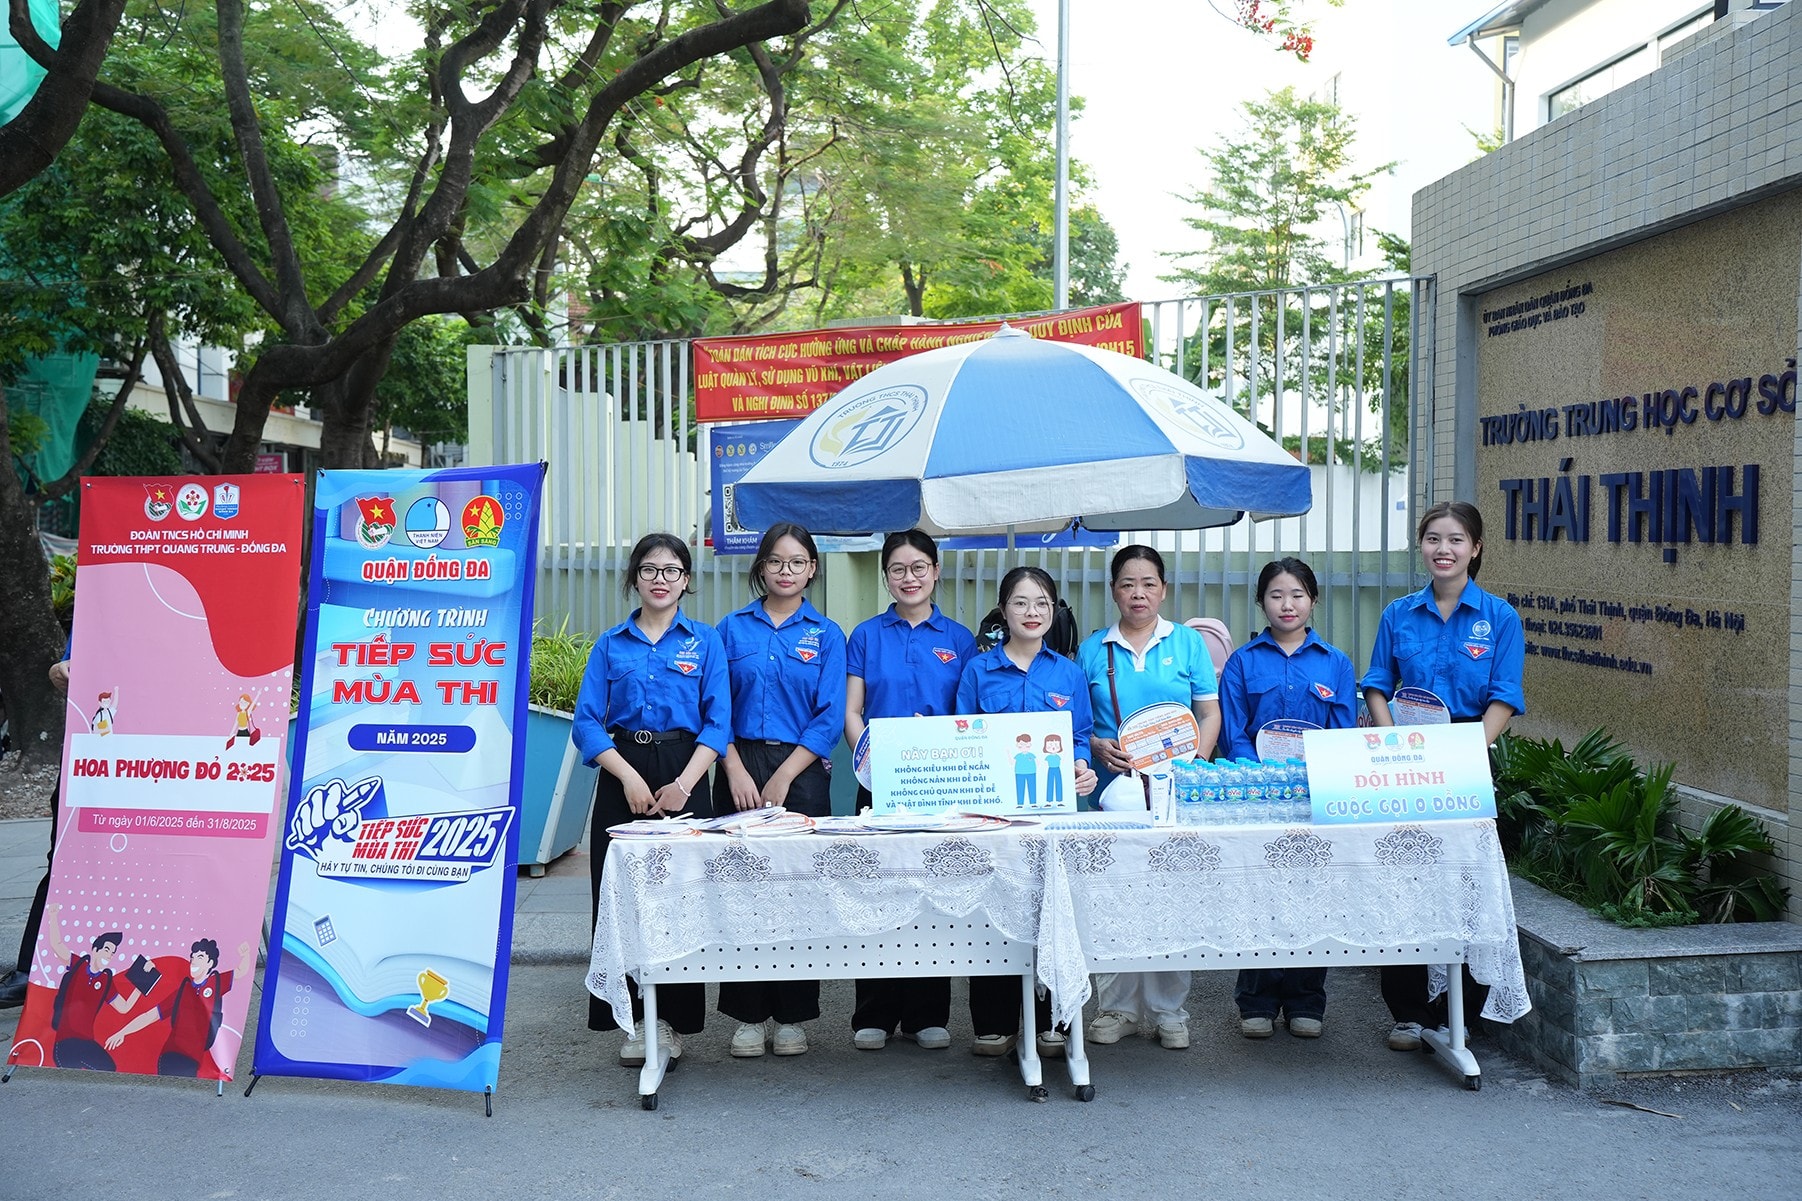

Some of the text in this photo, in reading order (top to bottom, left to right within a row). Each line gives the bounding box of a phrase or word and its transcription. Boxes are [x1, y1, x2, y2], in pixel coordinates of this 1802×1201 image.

[1569, 301, 1586, 319] TẠO
[733, 344, 752, 362] DÂN
[754, 343, 777, 361] TÍCH
[777, 343, 798, 362] CỰC
[799, 337, 832, 358] HƯỞNG
[834, 338, 857, 355] ỨNG
[859, 333, 874, 353] VÀ
[875, 331, 908, 352] CHẤP
[910, 333, 945, 350] HÀNH
[1028, 322, 1055, 339] QUY
[1057, 317, 1093, 338] ĐỊNH
[1095, 309, 1123, 331] CỦA
[698, 370, 718, 391] LUẬT
[746, 367, 762, 387] LÝ,
[761, 365, 776, 386] SỬ
[776, 369, 804, 389] DỤNG
[805, 366, 819, 383] VŨ
[820, 365, 842, 383] KHÍ,
[732, 394, 744, 412] VÀ
[746, 396, 768, 414] NGHỊ
[770, 395, 794, 414] ĐỊNH
[796, 388, 809, 410] SỐ
[1480, 403, 1559, 446] TRƯỜNG
[1562, 395, 1638, 437] TRUNG
[1643, 386, 1699, 435] HỌC
[1704, 377, 1752, 421] CƠ
[1499, 457, 1760, 564] THÁI THỊNH
[130, 527, 249, 541] ĐOÀN TNCS HỒ CHÍ MINH
[91, 542, 132, 554] TRƯỜNG
[134, 544, 161, 554] THPT
[162, 544, 199, 554] QUANG
[200, 543, 235, 554] TRUNG
[241, 540, 270, 553] ĐỐNG
[271, 543, 287, 553] ĐA
[362, 554, 490, 582] QUẬN ĐỐNG ĐA
[363, 606, 488, 627] CHƯƠNG TRÌNH
[1578, 598, 1597, 616] Thái
[1598, 600, 1627, 621] Thịnh,
[1628, 604, 1653, 624] quận
[1706, 608, 1721, 629] Hà
[1724, 611, 1745, 636] Nội
[331, 632, 507, 667] TIẾP SỨC
[331, 673, 499, 705] MÙA THI
[376, 729, 447, 745] NĂM 2025
[901, 746, 928, 761] NÀY
[930, 748, 958, 762] BẠN
[978, 746, 983, 758] !
[73, 758, 109, 778] HOA
[115, 757, 190, 784] PHƯỢNG
[194, 755, 221, 780] ĐỎ
[894, 765, 922, 774] KHÔNG
[1354, 769, 1445, 790] ĐỘI HÌNH
[900, 776, 928, 785] KHÔNG
[890, 788, 919, 797] KHÔNG
[936, 788, 958, 796] QUAN
[886, 800, 896, 808] VÀ
[1325, 796, 1372, 819] CUỘC
[1378, 797, 1408, 817] GỌI
[1432, 789, 1481, 812] ĐỒNG
[93, 813, 257, 831] Từ ngày 01/6/2025 đến 31/8/2025
[358, 813, 503, 857] TIẾP SỨC 2025
[352, 840, 419, 860] MÙA THI
[320, 861, 469, 880] HÃY TỰ TIN, CHÚNG TÔI ĐI CÙNG BẠN
